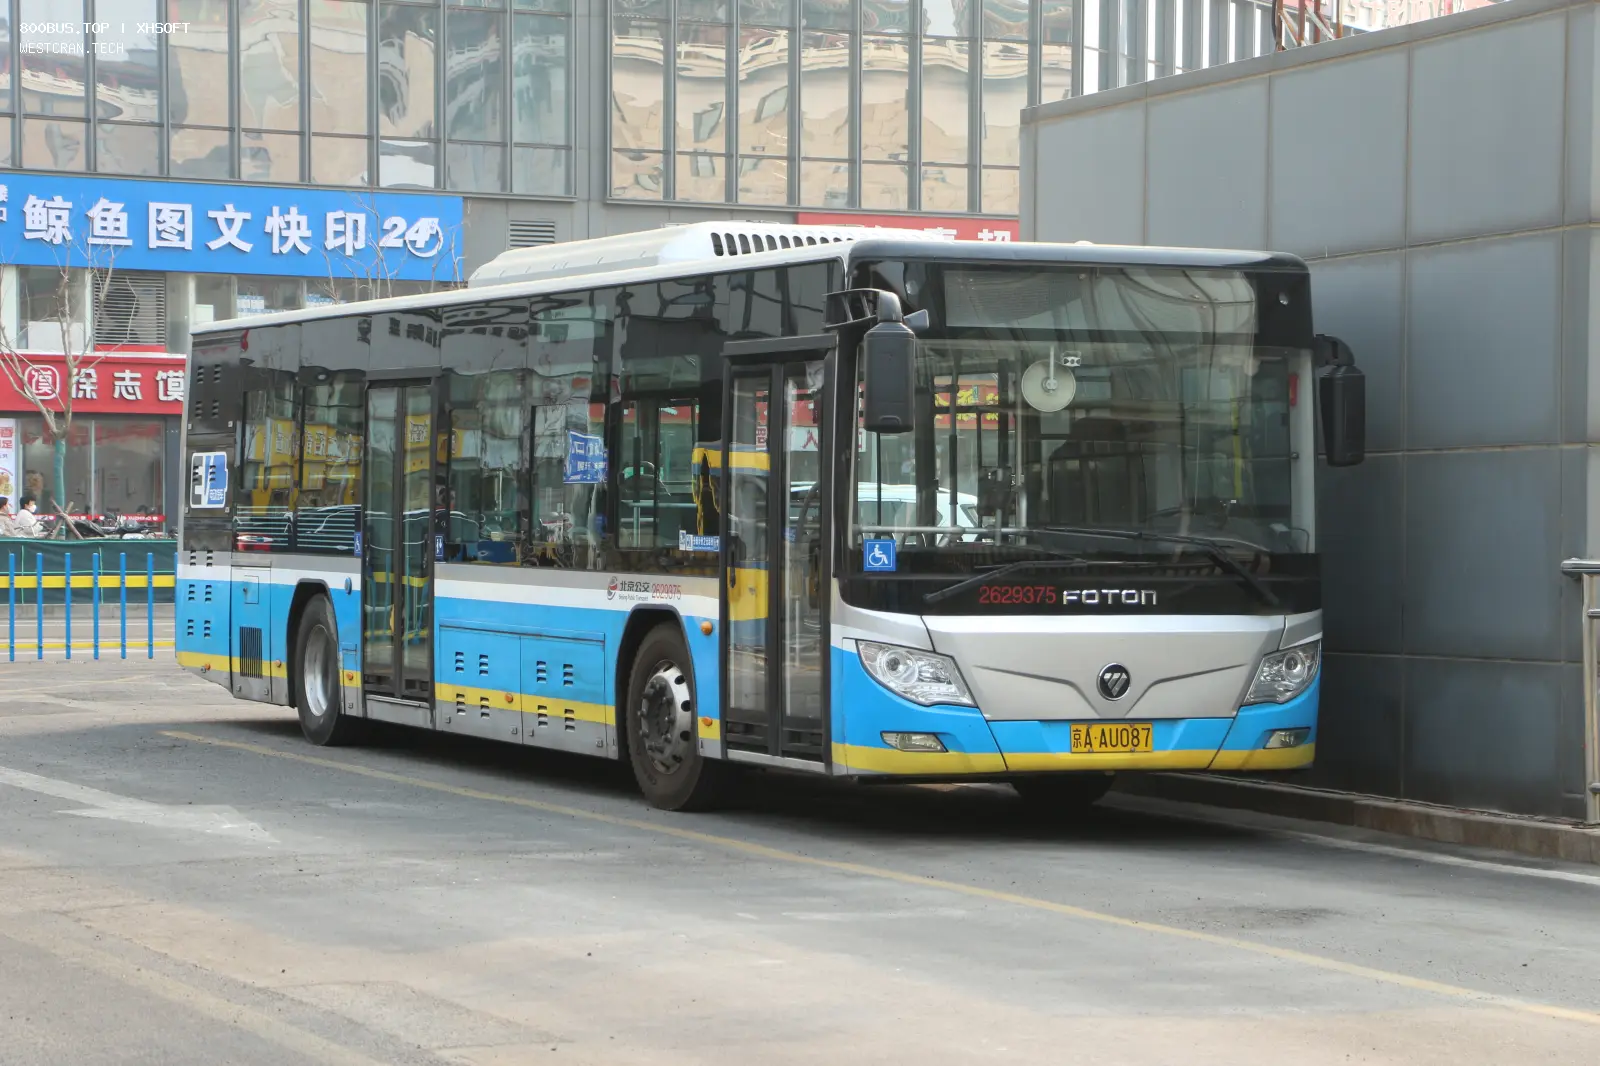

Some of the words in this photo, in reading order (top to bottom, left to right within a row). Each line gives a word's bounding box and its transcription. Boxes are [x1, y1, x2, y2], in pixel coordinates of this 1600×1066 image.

[23, 194, 366, 257] 鲸鱼图文快印
[620, 581, 650, 592] 北京公交
[652, 584, 681, 600] 2629375
[979, 586, 1056, 603] 2629375
[1062, 589, 1156, 605] FOTON
